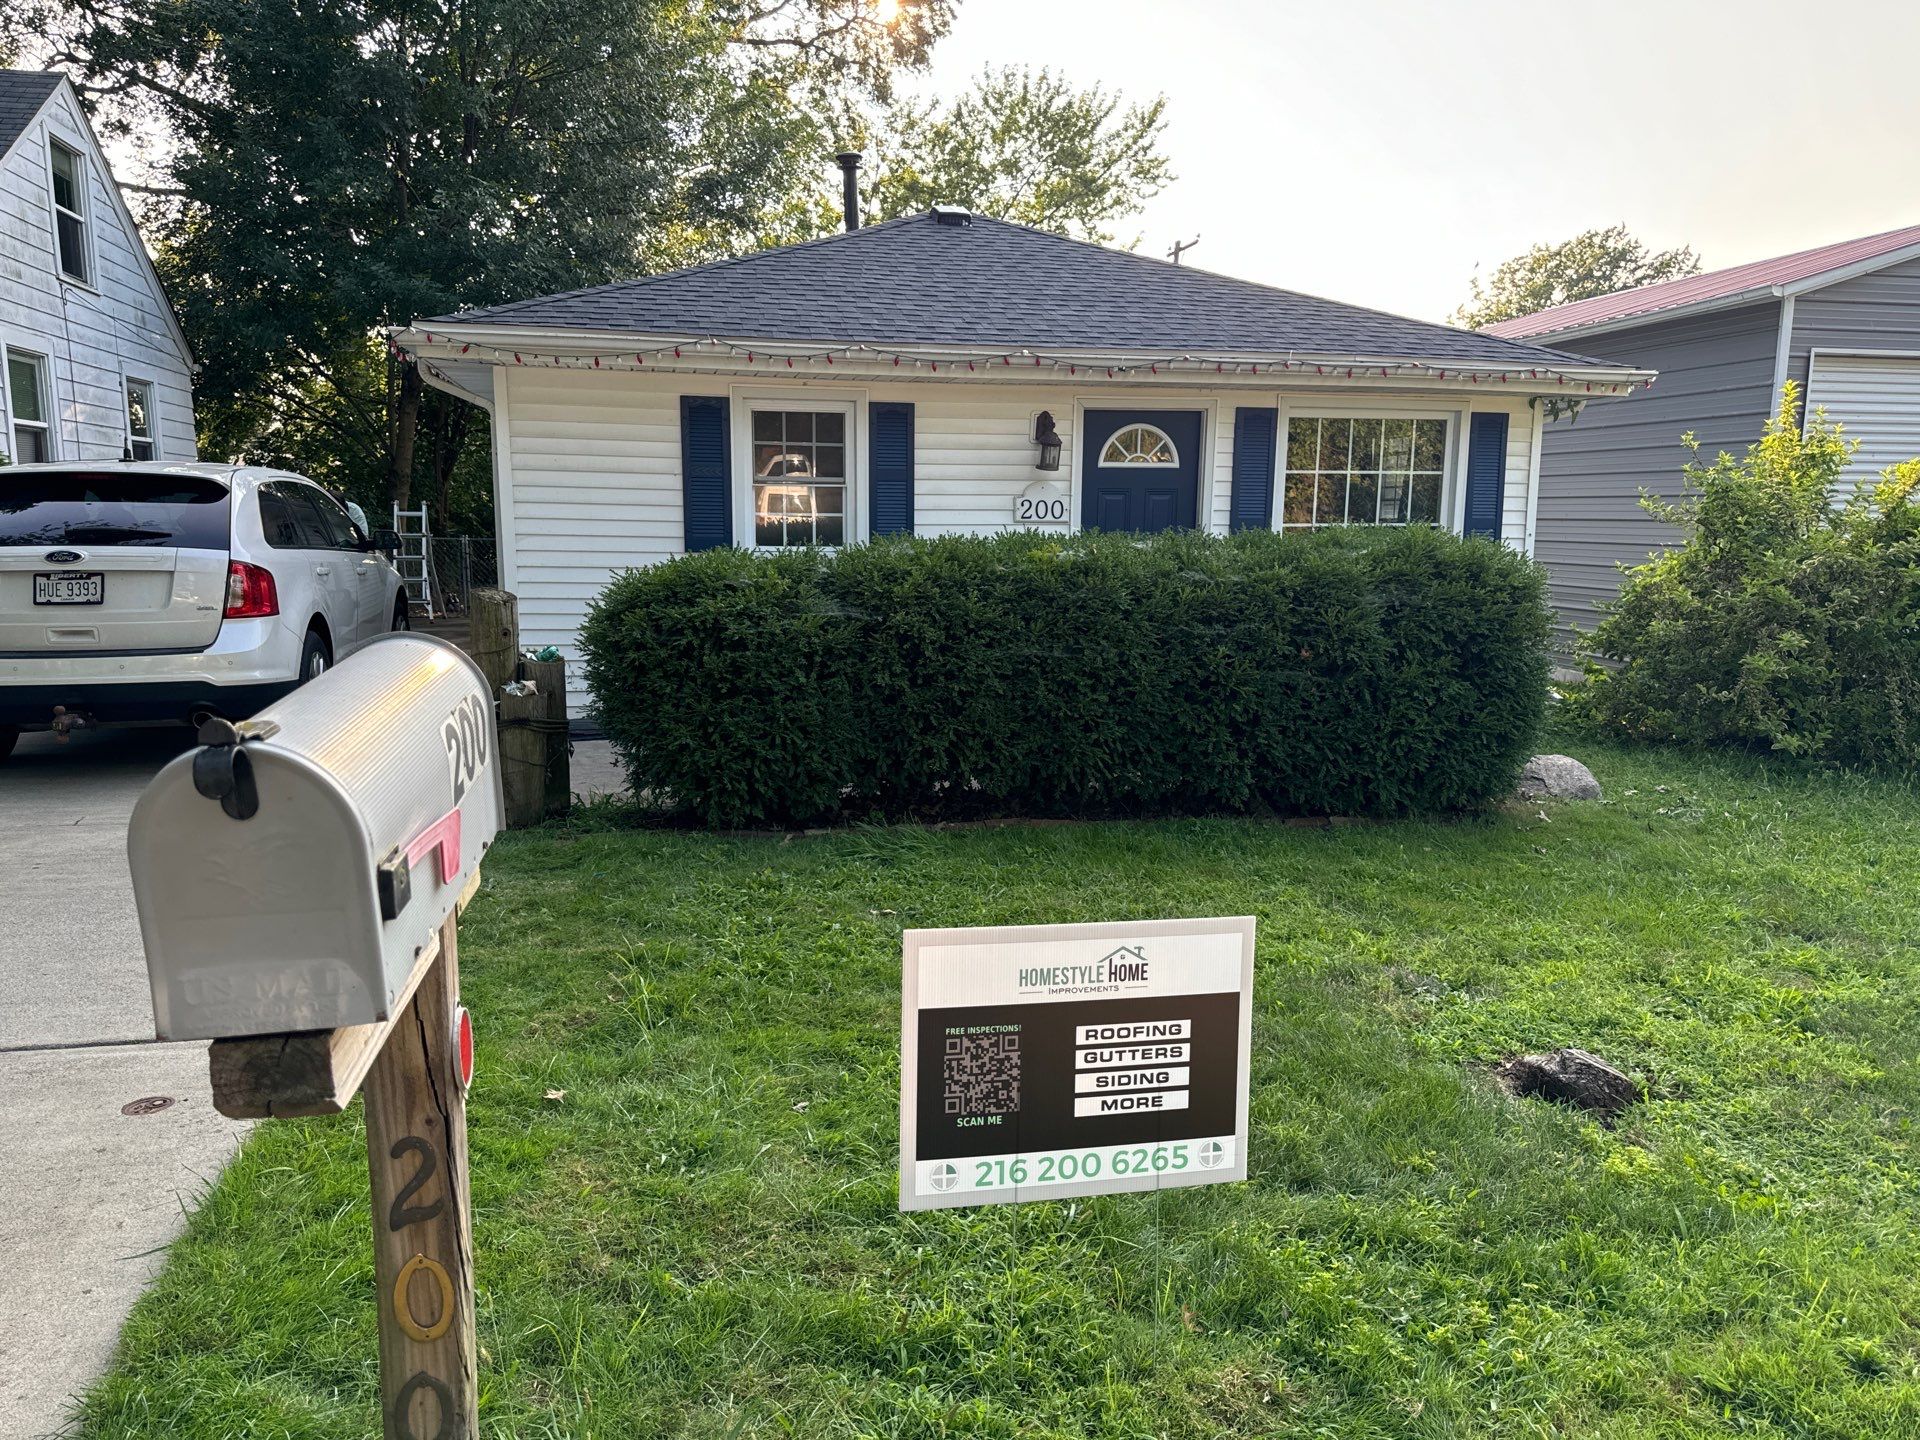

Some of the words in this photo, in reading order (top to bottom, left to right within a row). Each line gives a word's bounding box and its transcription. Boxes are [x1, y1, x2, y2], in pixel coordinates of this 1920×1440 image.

[1020, 499, 1064, 520] 200
[52, 552, 75, 561] Ford
[38, 582, 62, 598] HUE
[66, 581, 98, 597] 9393
[445, 693, 487, 807] 200
[1018, 965, 1104, 987] HOMESTYLE
[1108, 958, 1149, 983] HOME
[1048, 984, 1120, 995] IMPROVEMENTS
[945, 1027, 965, 1036] FREE
[967, 1024, 1022, 1034] INSPECTIONS!
[1085, 1023, 1182, 1041] ROOFING
[1083, 1046, 1183, 1064] GUTTERS
[1095, 1071, 1170, 1088] SIDING
[1100, 1095, 1163, 1112] MORE
[956, 1117, 984, 1127] SCAN
[987, 1115, 1003, 1125] ME
[974, 1158, 1028, 1187] 216
[1037, 1152, 1101, 1182] 200
[1111, 1145, 1189, 1175] 6265
